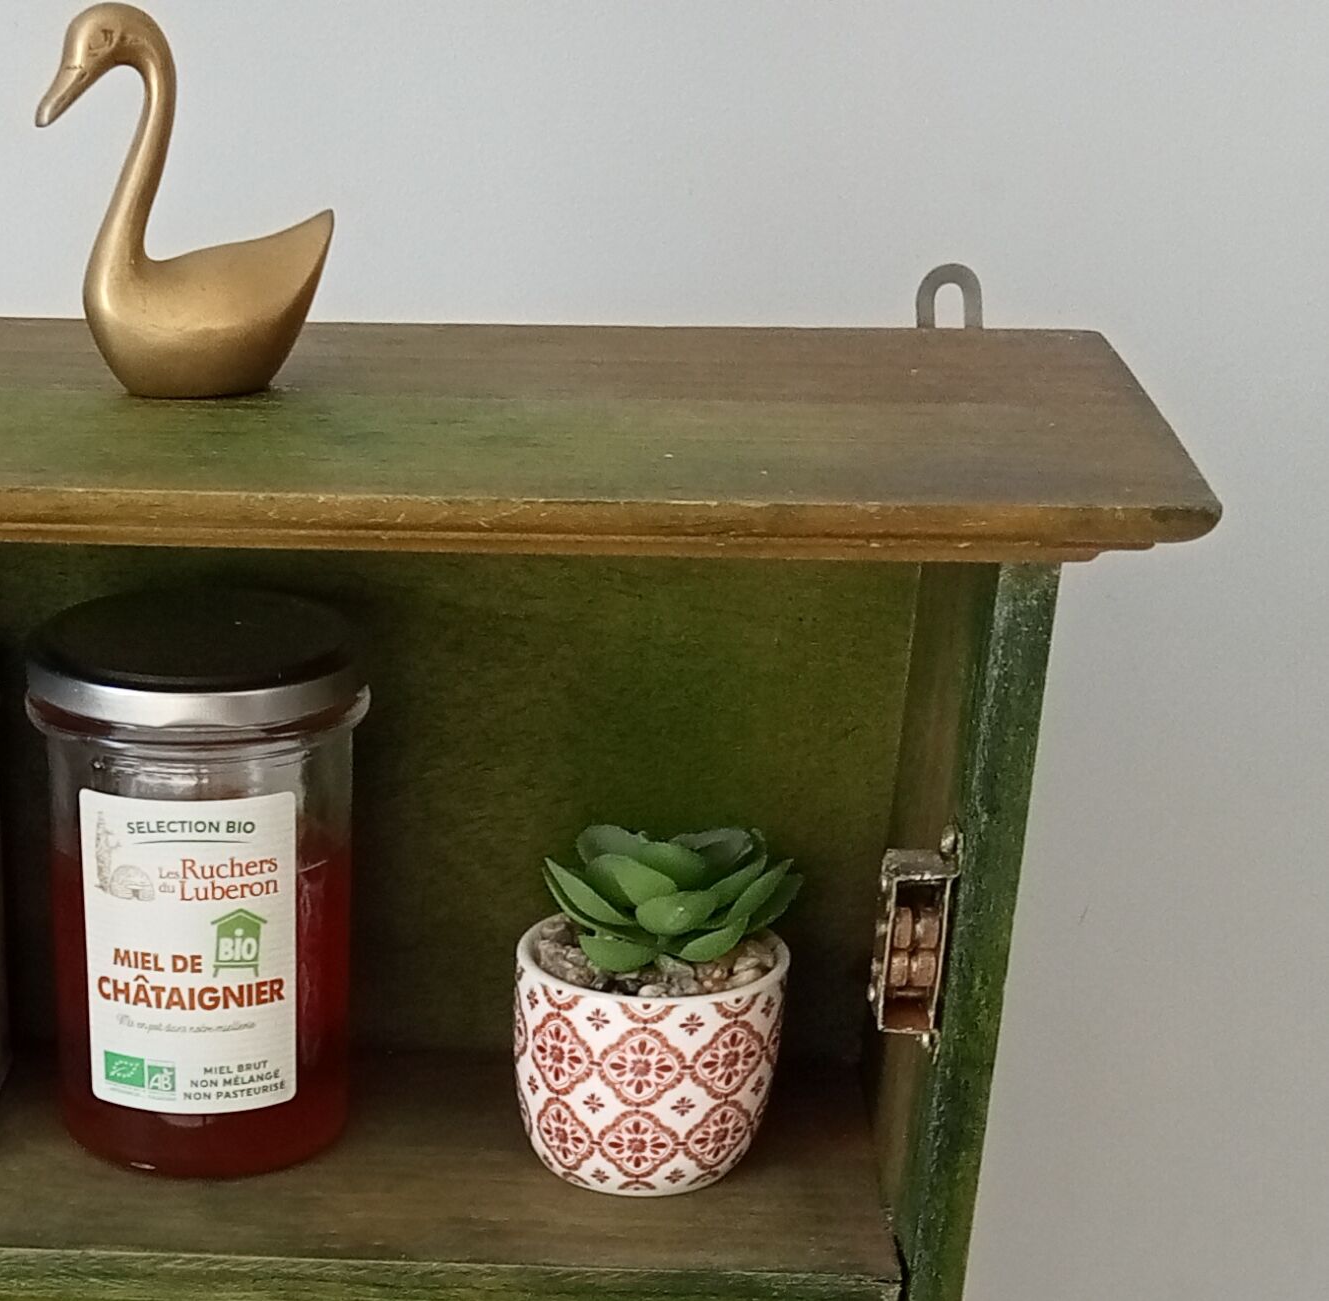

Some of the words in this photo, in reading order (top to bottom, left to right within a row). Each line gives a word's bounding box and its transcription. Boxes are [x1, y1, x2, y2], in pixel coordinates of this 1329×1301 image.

[126, 820, 220, 834] SELECTION
[225, 820, 256, 834] BIO
[158, 867, 179, 879] Les
[180, 857, 278, 880] Ruchers
[158, 882, 175, 893] du
[179, 879, 279, 901] Luberon
[113, 948, 165, 972] MIEL
[172, 955, 203, 974] DE
[97, 974, 285, 1011] CHÂTAIGNIER
[203, 1066, 233, 1075] MIEL
[237, 1059, 268, 1073] BRUT
[149, 1074, 173, 1091] AB
[190, 1079, 218, 1088] NON
[183, 1091, 211, 1100] NON
